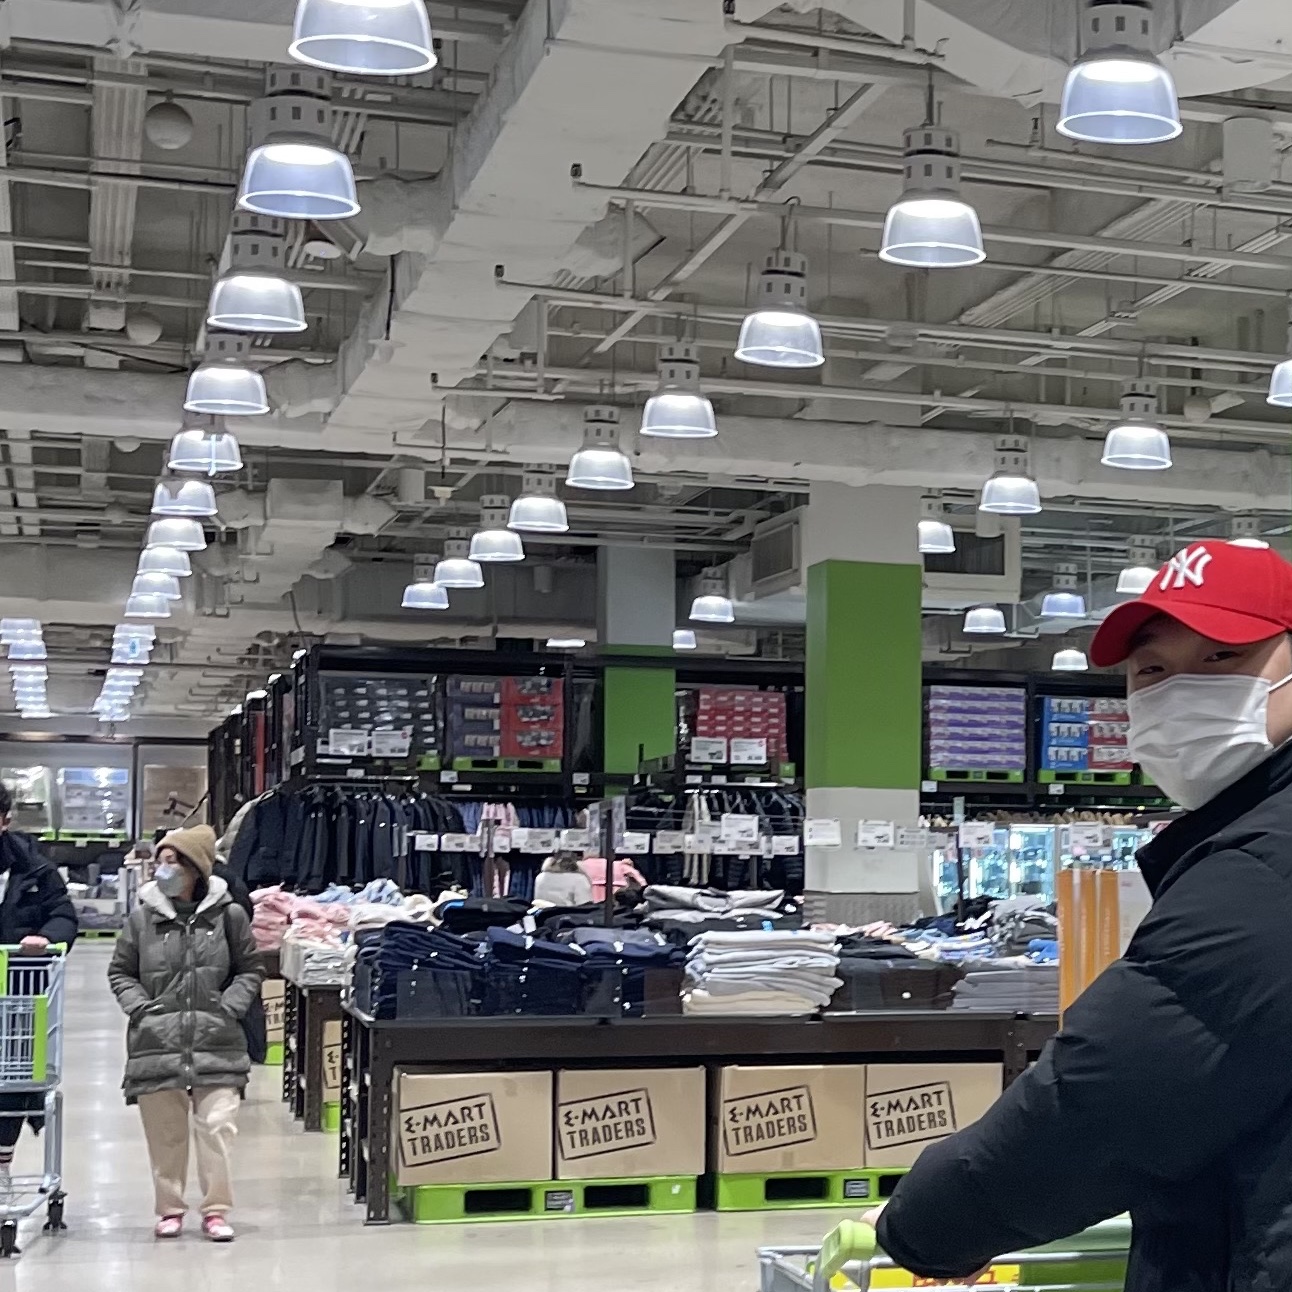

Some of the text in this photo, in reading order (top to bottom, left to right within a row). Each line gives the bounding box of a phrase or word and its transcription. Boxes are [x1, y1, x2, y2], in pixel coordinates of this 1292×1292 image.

[1159, 546, 1212, 591] NY
[407, 1123, 491, 1157] TRADERS
[566, 1117, 646, 1150] TRADERS
[731, 1113, 808, 1146] TRADERS
[872, 1109, 948, 1140] TRADERS
